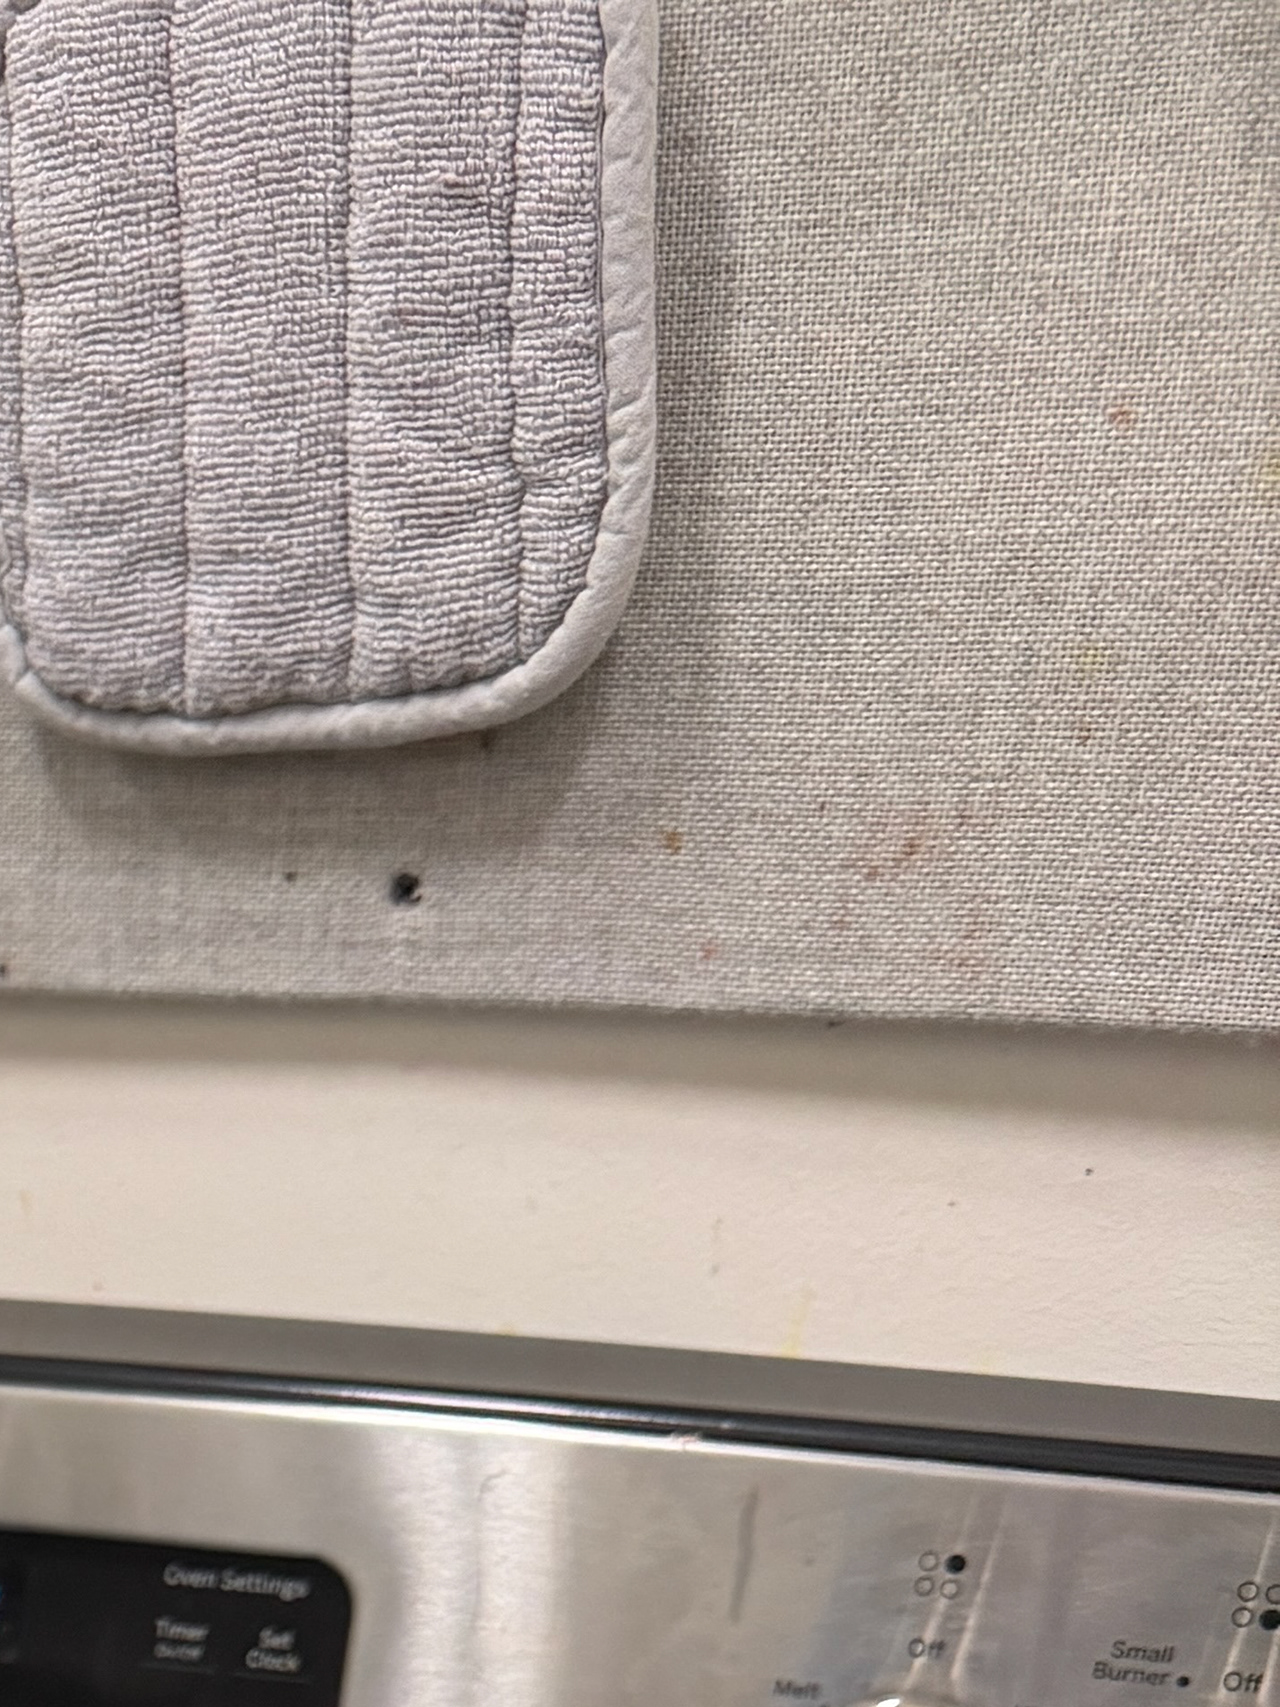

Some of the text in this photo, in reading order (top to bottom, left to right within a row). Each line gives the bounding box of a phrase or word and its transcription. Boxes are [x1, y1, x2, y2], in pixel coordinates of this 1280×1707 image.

[163, 1561, 311, 1602] Oven Settings
[154, 1615, 211, 1643] Timer
[258, 1625, 296, 1650] Set
[907, 1636, 947, 1659] Off
[1109, 1638, 1176, 1664] Small
[244, 1648, 302, 1674] Clock
[1091, 1660, 1171, 1688] Burner
[1223, 1670, 1264, 1694] Off
